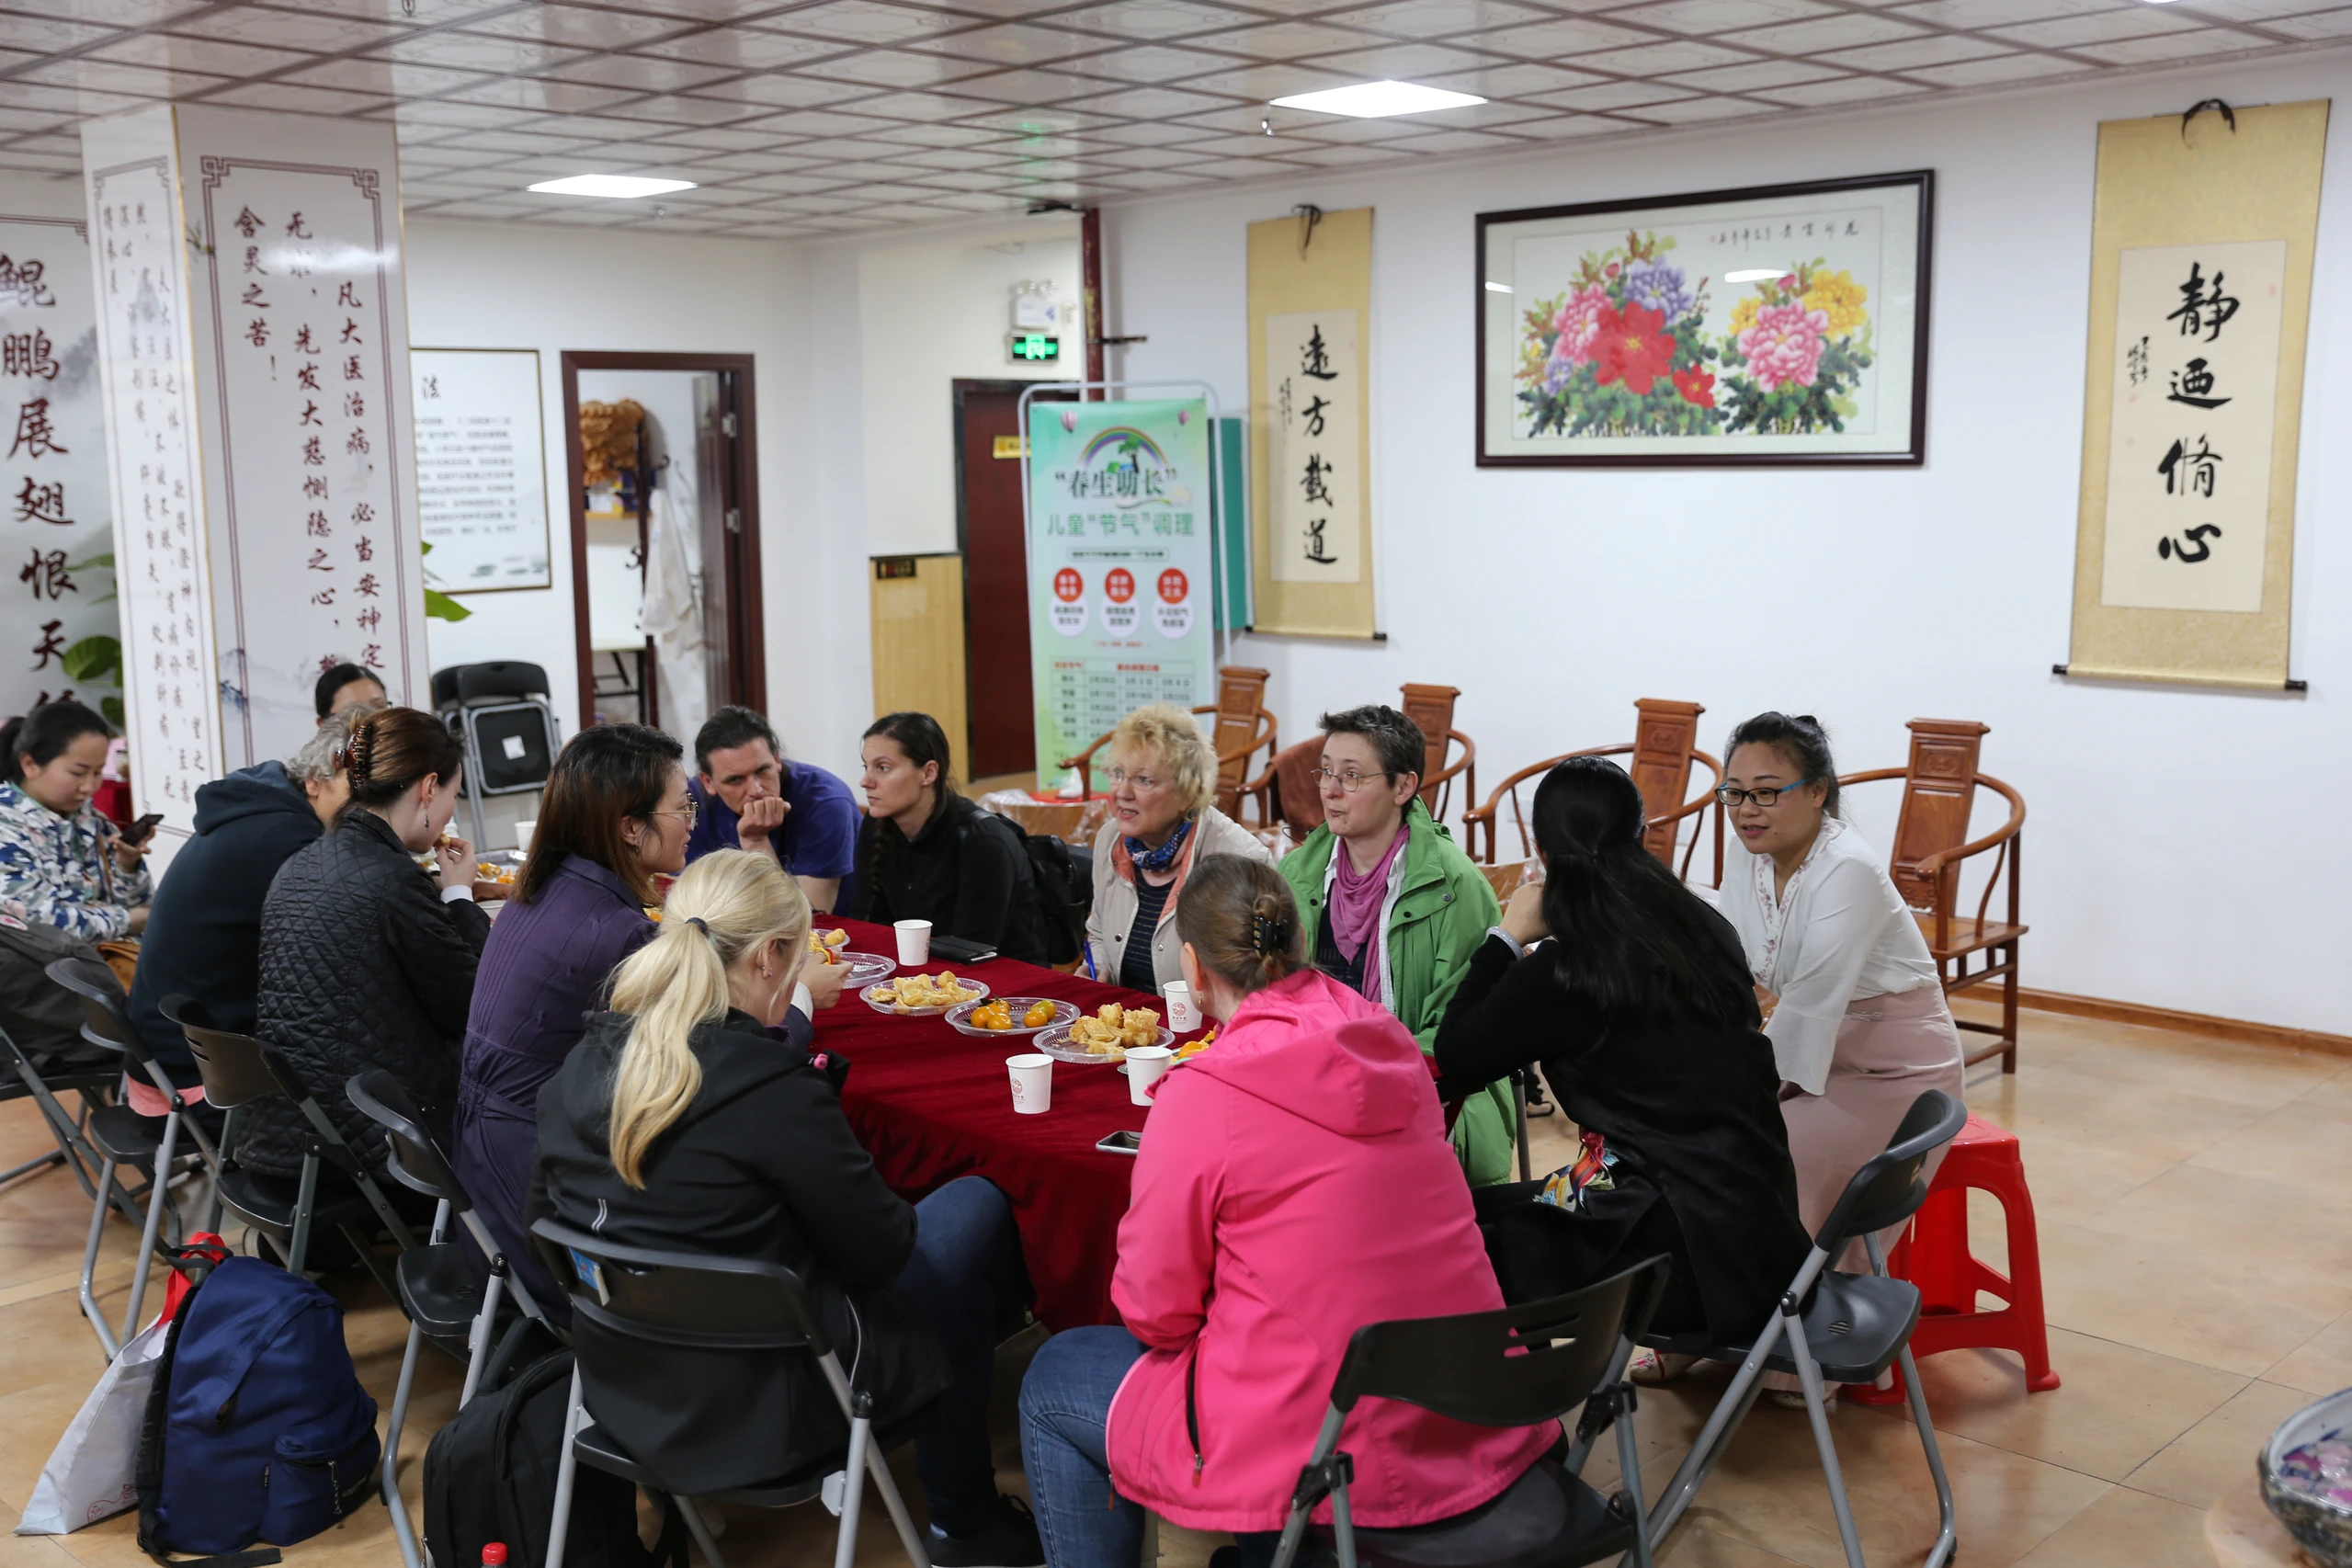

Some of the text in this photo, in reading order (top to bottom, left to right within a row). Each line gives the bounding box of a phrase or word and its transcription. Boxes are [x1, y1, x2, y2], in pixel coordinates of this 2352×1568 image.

[0, 254, 82, 713] 鲲鹏展翅恨天
